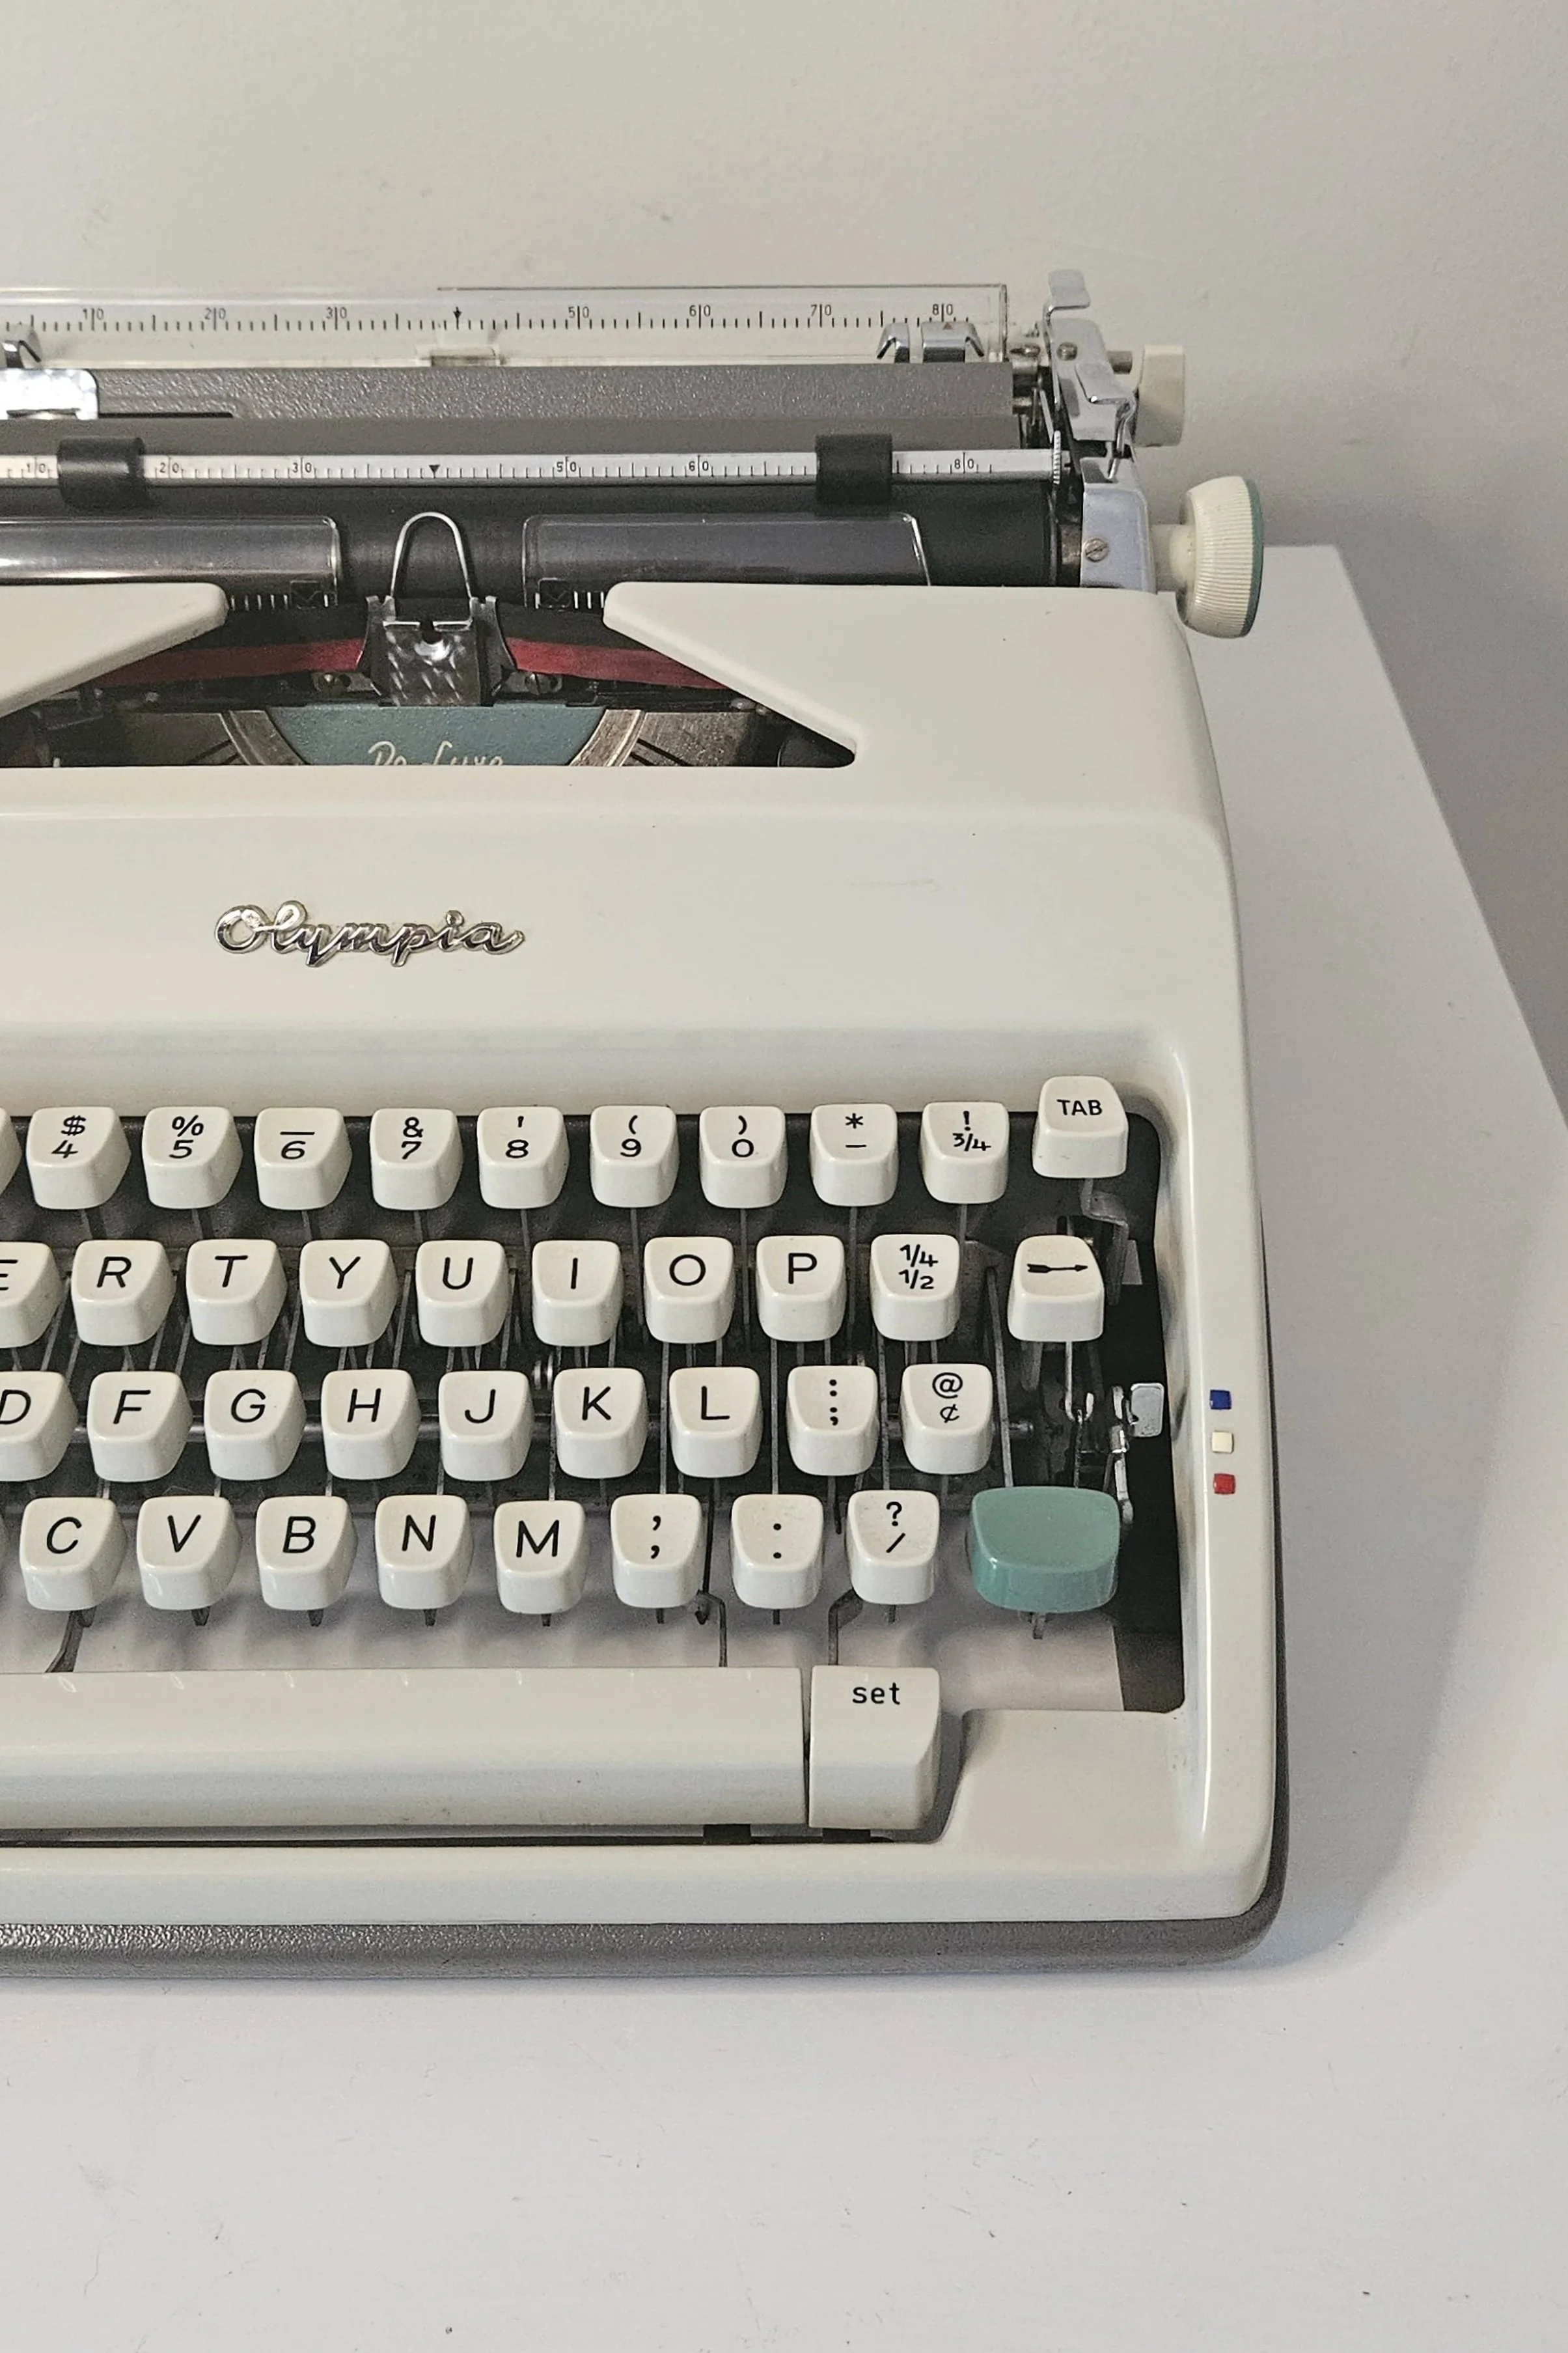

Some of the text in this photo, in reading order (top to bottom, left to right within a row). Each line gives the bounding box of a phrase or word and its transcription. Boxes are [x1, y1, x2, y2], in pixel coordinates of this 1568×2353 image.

[215, 900, 525, 968] Olympia
[1056, 1099, 1103, 1116] TAB
[61, 1115, 86, 1136] $
[172, 1115, 204, 1137] %
[403, 1117, 424, 1137] &
[628, 1115, 638, 1135] (
[738, 1115, 747, 1135] )
[963, 1111, 971, 1132] !
[52, 1139, 78, 1159] 4
[169, 1139, 193, 1159] 5
[281, 1140, 305, 1160] 6
[402, 1141, 421, 1160] 7
[506, 1139, 529, 1159] 8
[620, 1138, 641, 1158] 9
[732, 1138, 754, 1158] 0
[788, 1252, 818, 1285] P
[900, 1244, 939, 1268] 1/4
[97, 1256, 132, 1288] R
[215, 1255, 248, 1288] T
[329, 1256, 361, 1290] Y
[443, 1257, 474, 1290] U
[570, 1257, 579, 1290] I
[669, 1254, 706, 1286] O
[898, 1269, 935, 1290] 1/2
[931, 1372, 963, 1399] @
[0, 1389, 31, 1425] D
[113, 1389, 151, 1425] F
[230, 1388, 266, 1423] G
[347, 1387, 381, 1423] H
[465, 1389, 496, 1424] J
[582, 1386, 612, 1421] K
[701, 1385, 730, 1421] L
[939, 1404, 960, 1424] ¢
[886, 1501, 903, 1527] ?
[46, 1516, 82, 1554] C
[167, 1514, 201, 1553] V
[282, 1516, 316, 1553] B
[402, 1514, 436, 1552] N
[516, 1520, 560, 1558] M
[886, 1533, 906, 1553] /
[852, 1682, 901, 1705] set
